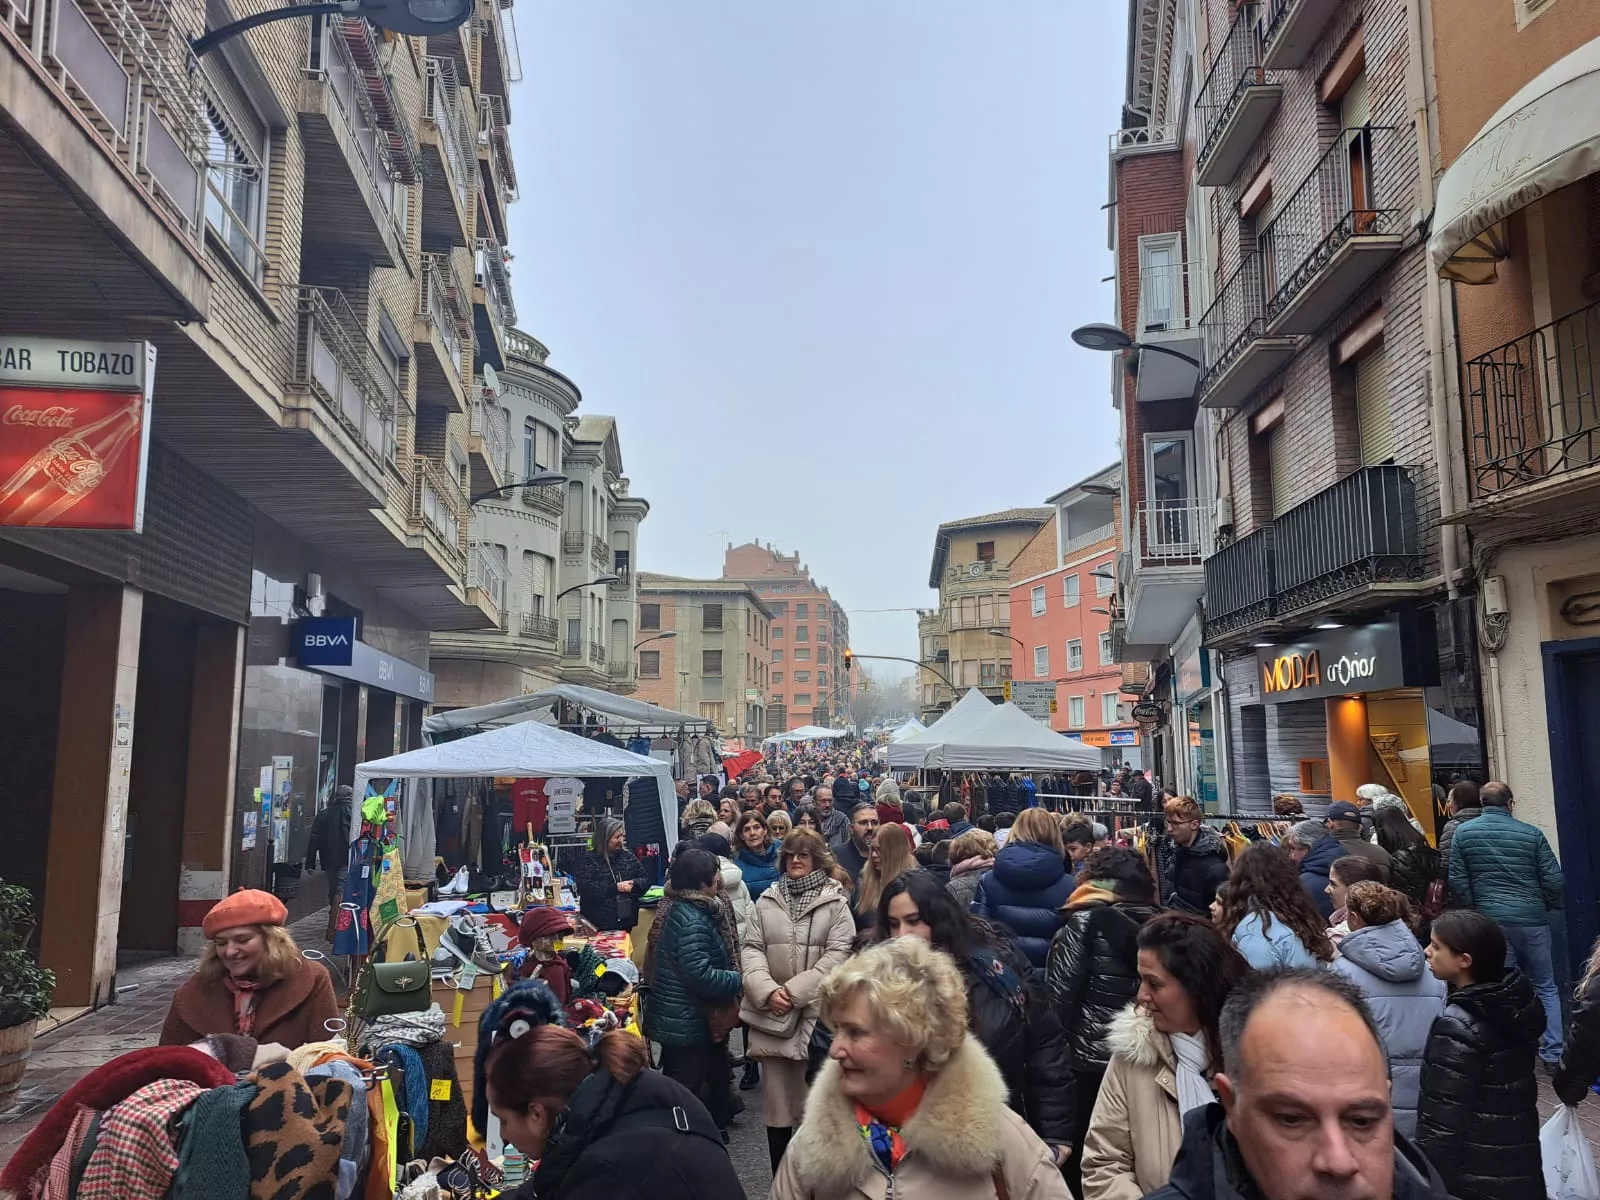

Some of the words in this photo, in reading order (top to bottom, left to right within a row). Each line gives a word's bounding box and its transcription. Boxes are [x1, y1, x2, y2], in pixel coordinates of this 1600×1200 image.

[0, 348, 31, 370] AR
[57, 350, 133, 375] TOBAZO
[304, 634, 348, 647] BBVA
[1263, 649, 1320, 693] MODA
